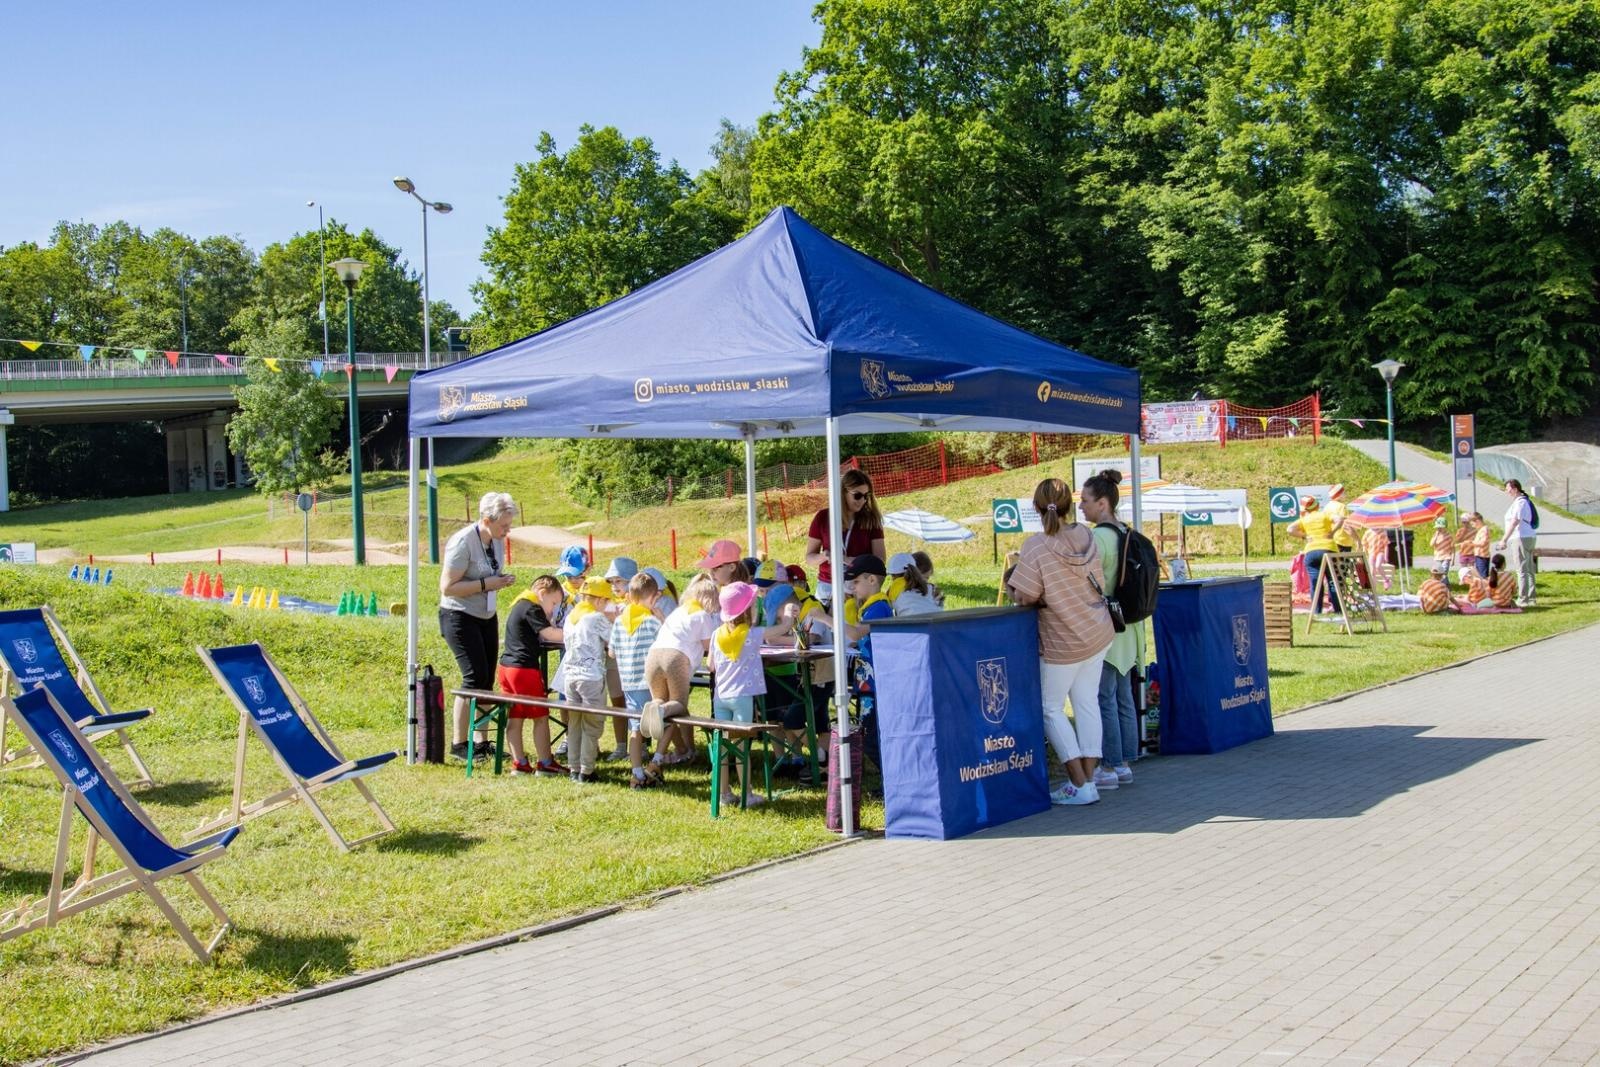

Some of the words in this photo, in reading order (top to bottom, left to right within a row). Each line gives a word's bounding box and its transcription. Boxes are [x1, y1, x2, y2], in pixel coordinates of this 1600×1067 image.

[656, 376, 789, 395] miasto_wodzislaw_slaski
[984, 734, 1015, 754] Miasto
[960, 760, 1009, 783] Wodzisław
